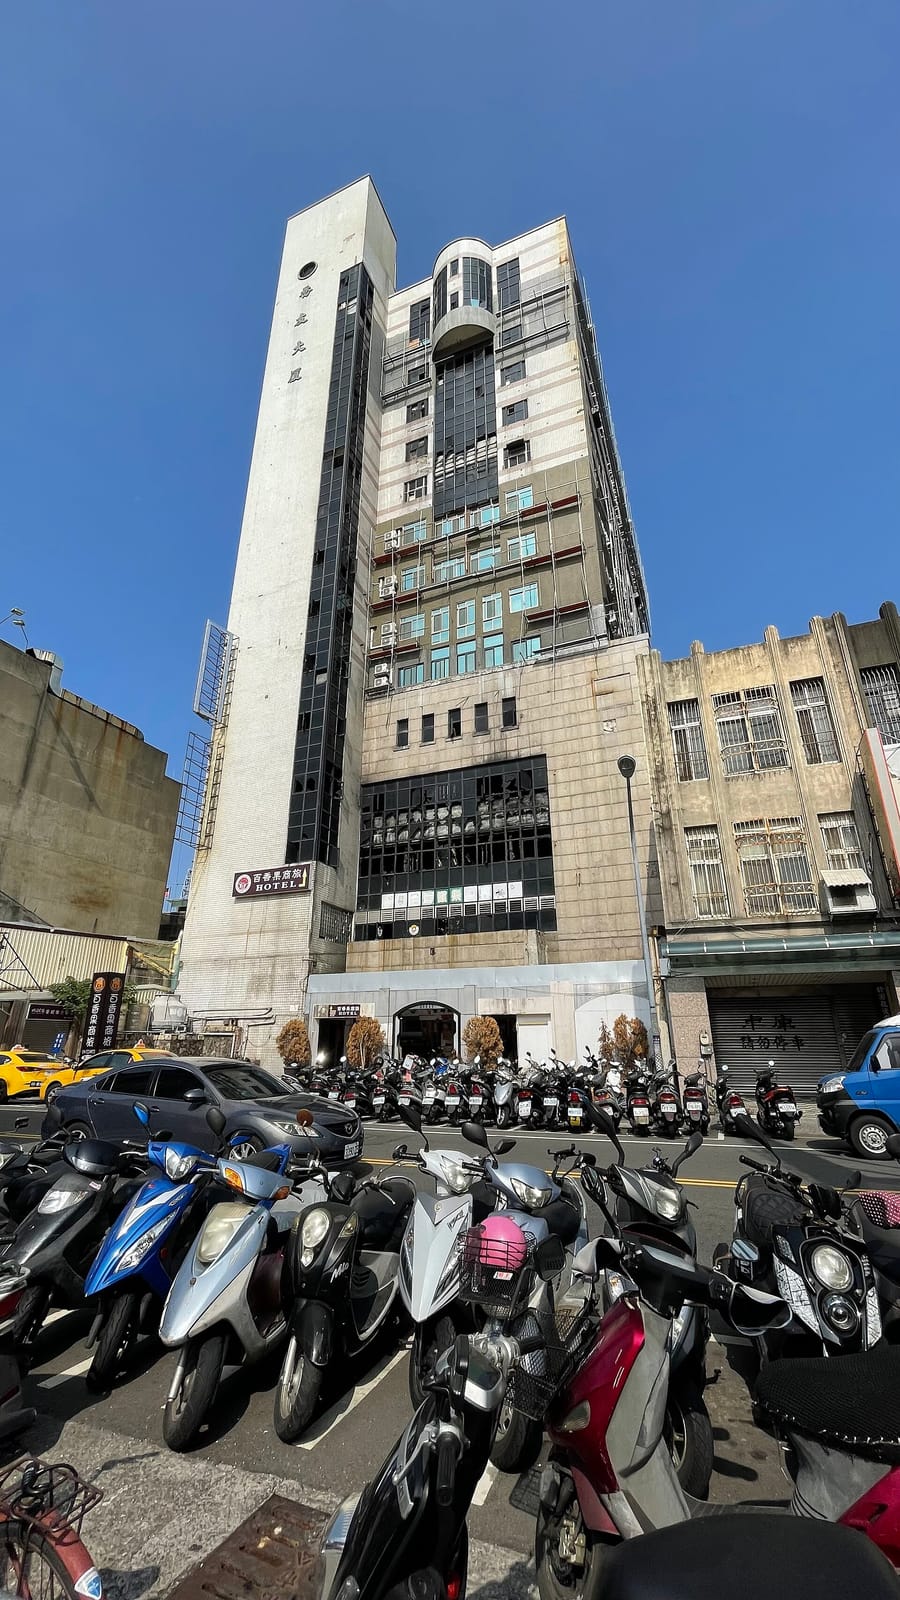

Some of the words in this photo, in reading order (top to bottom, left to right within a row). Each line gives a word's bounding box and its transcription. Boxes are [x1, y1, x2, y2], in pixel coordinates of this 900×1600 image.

[253, 869, 302, 883] 百香果商旅
[256, 880, 297, 892] HOTEL
[86, 993, 102, 1048] 百香果商旅
[103, 993, 119, 1047] 百香果商旅
